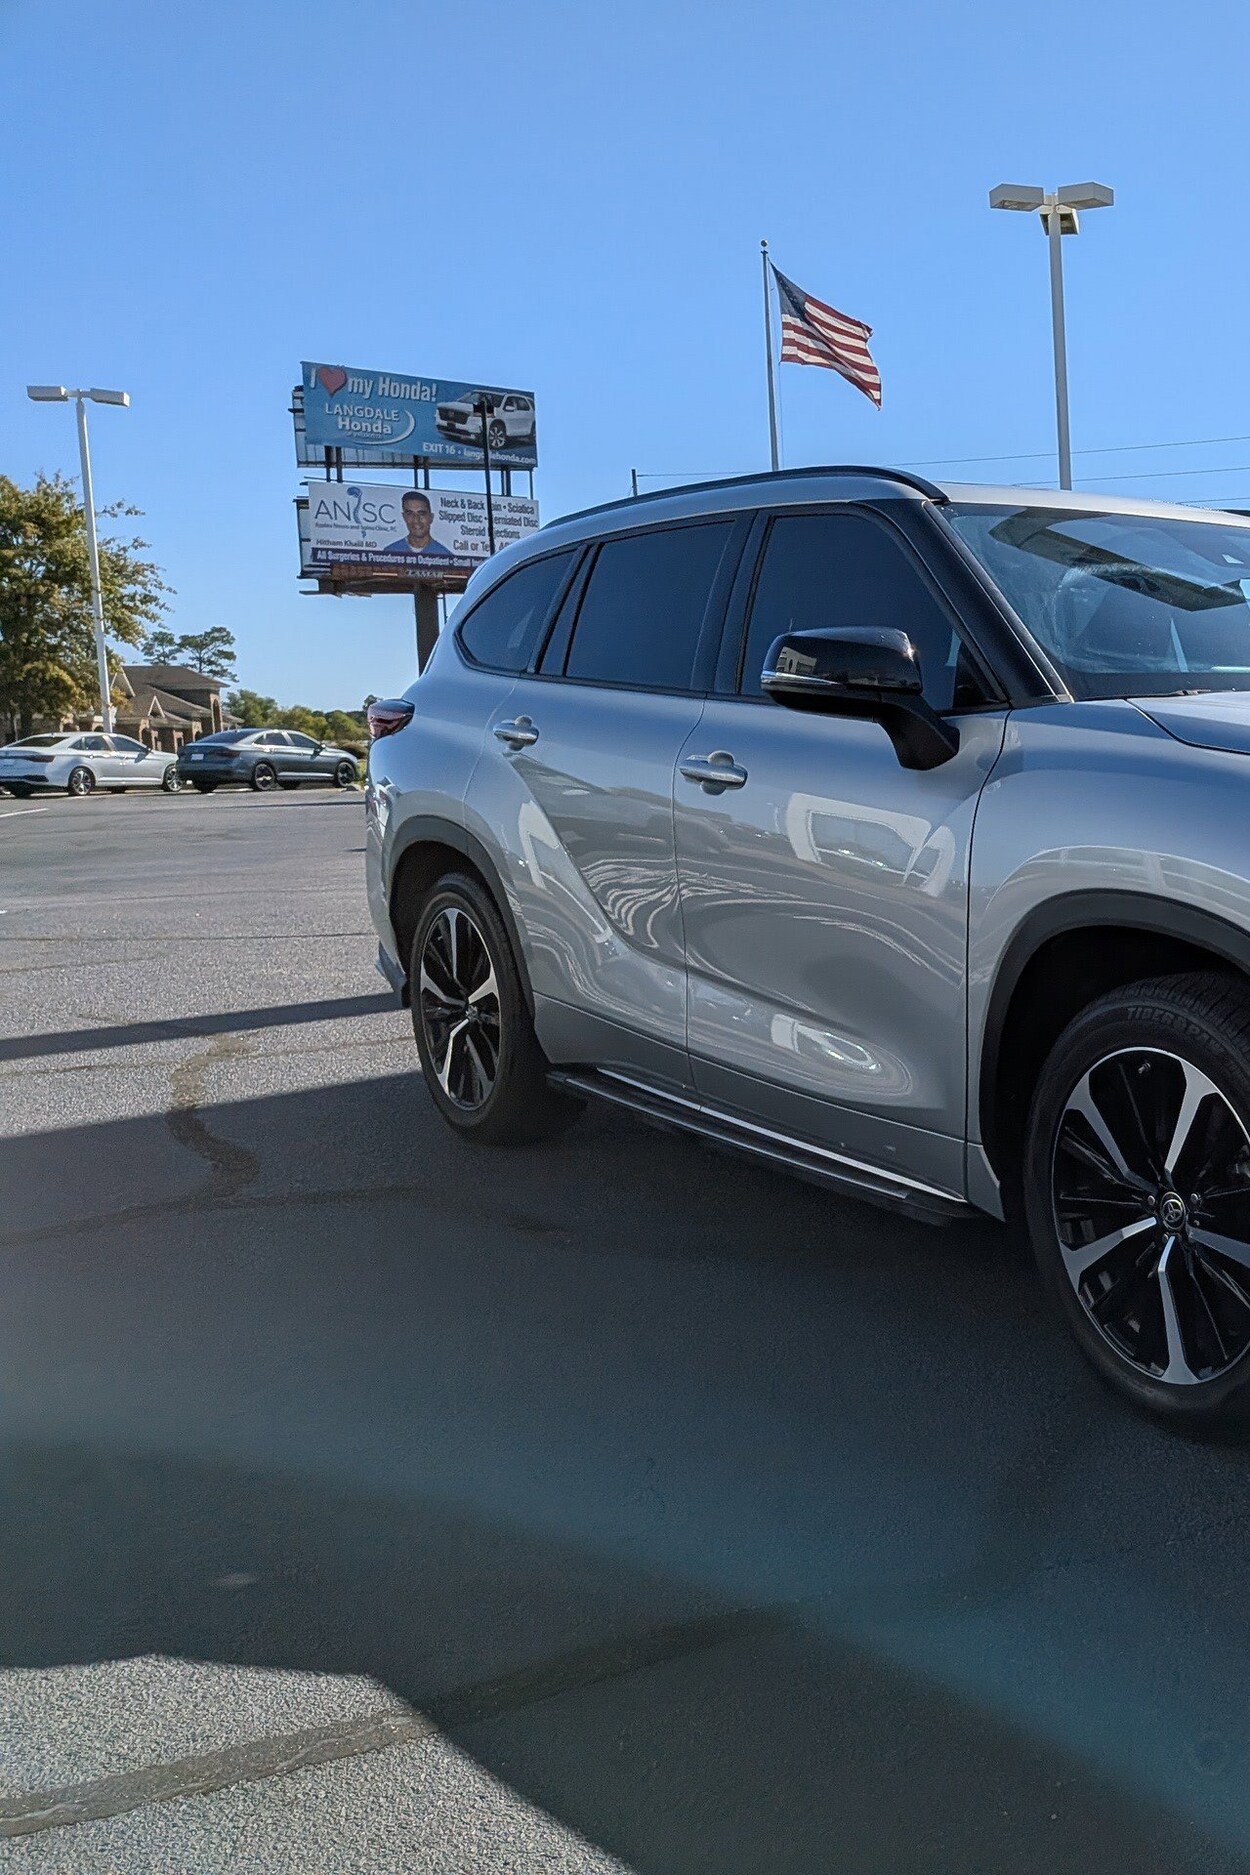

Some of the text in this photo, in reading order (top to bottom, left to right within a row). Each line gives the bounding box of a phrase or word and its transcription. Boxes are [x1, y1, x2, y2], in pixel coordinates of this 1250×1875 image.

[310, 367, 437, 402] I my Honda!
[324, 402, 401, 421] LANGDALE
[337, 416, 392, 434] Honda
[422, 442, 444, 454] EXIT
[446, 446, 456, 455] 16
[440, 496, 459, 509] Neck
[460, 498, 466, 509] &
[467, 499, 485, 510] Back
[487, 501, 502, 512] ain
[439, 510, 539, 528] Slipped Disc erniated Disc
[460, 525, 520, 539] Steroid jections
[453, 539, 468, 551] Call
[470, 543, 479, 551] or
[316, 550, 327, 559] All
